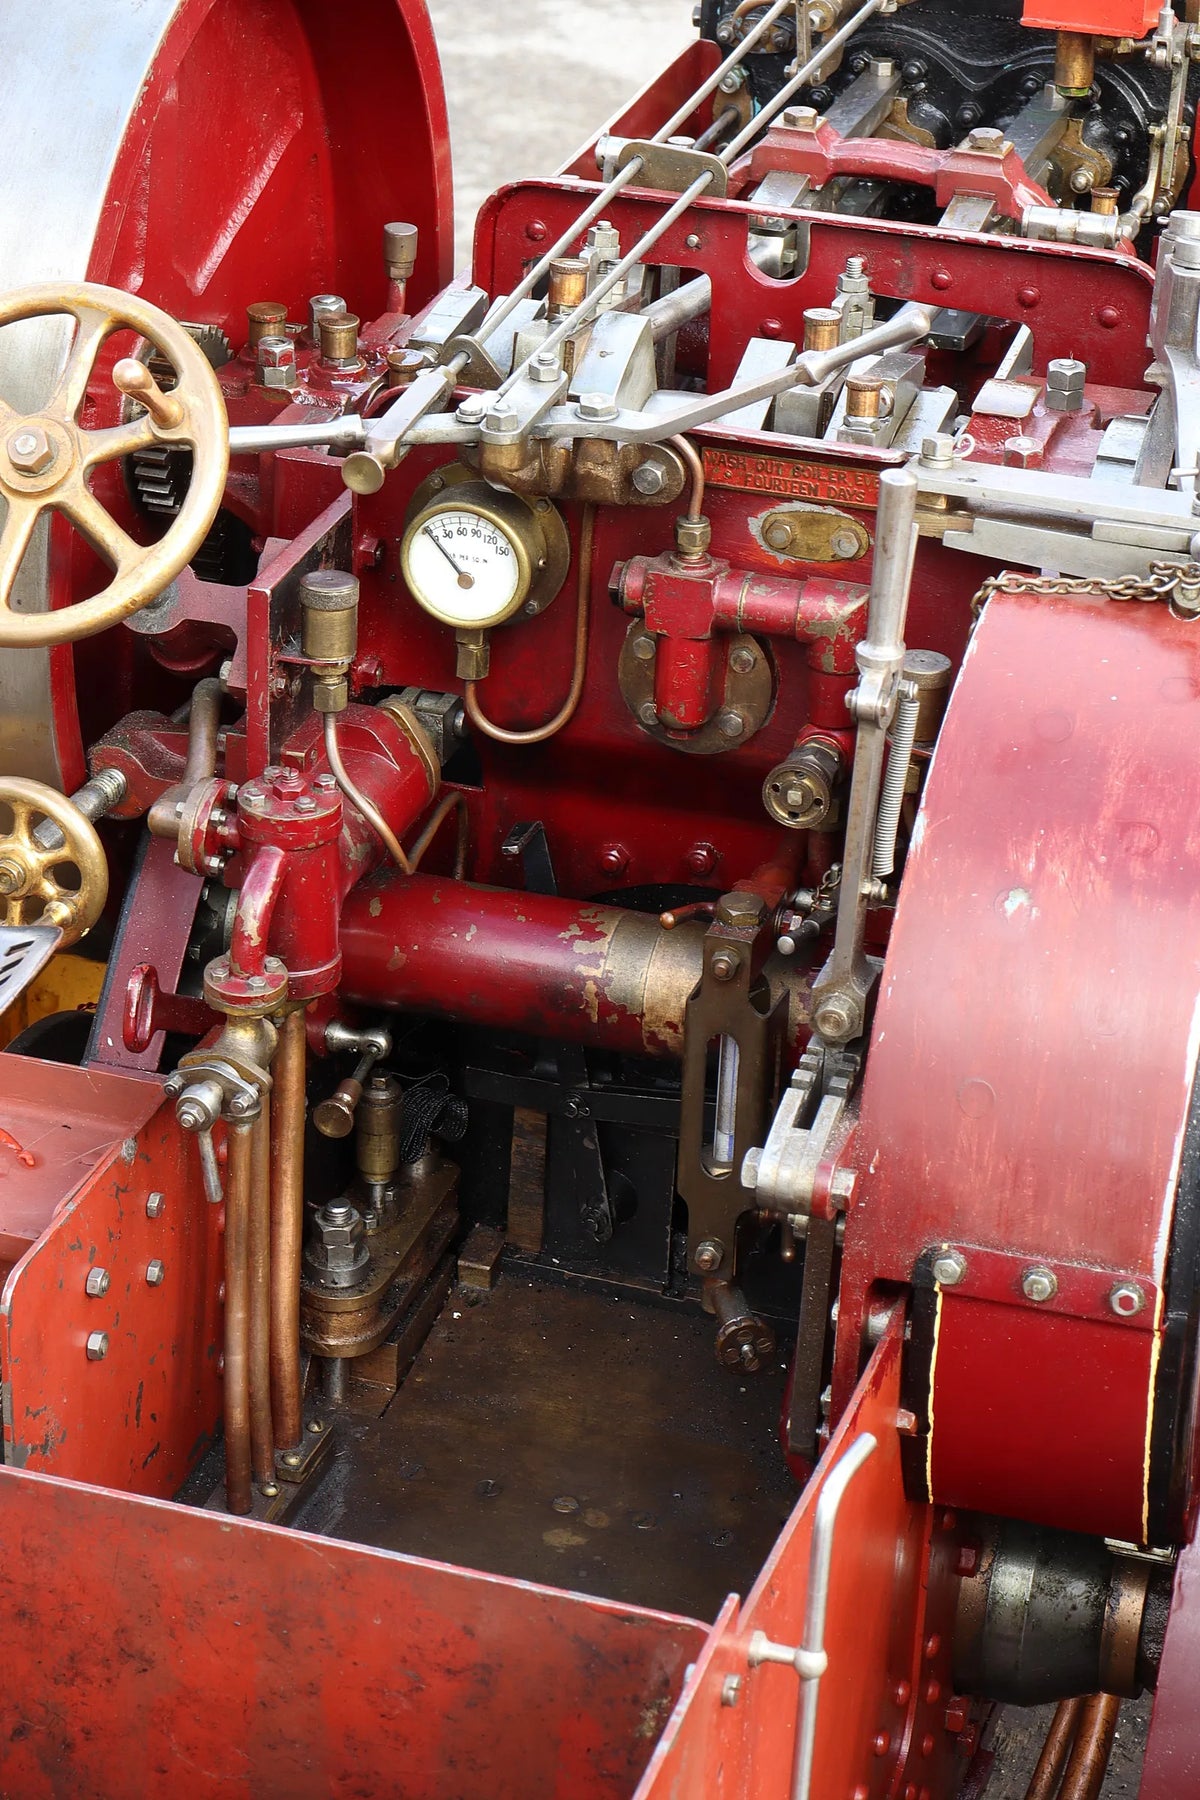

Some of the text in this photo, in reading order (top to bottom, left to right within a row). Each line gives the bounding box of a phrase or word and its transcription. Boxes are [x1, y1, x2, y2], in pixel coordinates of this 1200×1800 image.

[705, 451, 747, 469] WASH
[755, 459, 785, 474] OUT
[791, 464, 848, 485] BOILER
[744, 472, 865, 503] FOURTEEN DAYS
[442, 528, 454, 539] 30
[456, 526, 468, 537] 60
[470, 528, 482, 539] 90
[483, 534, 498, 545] 120
[495, 545, 510, 557] 150
